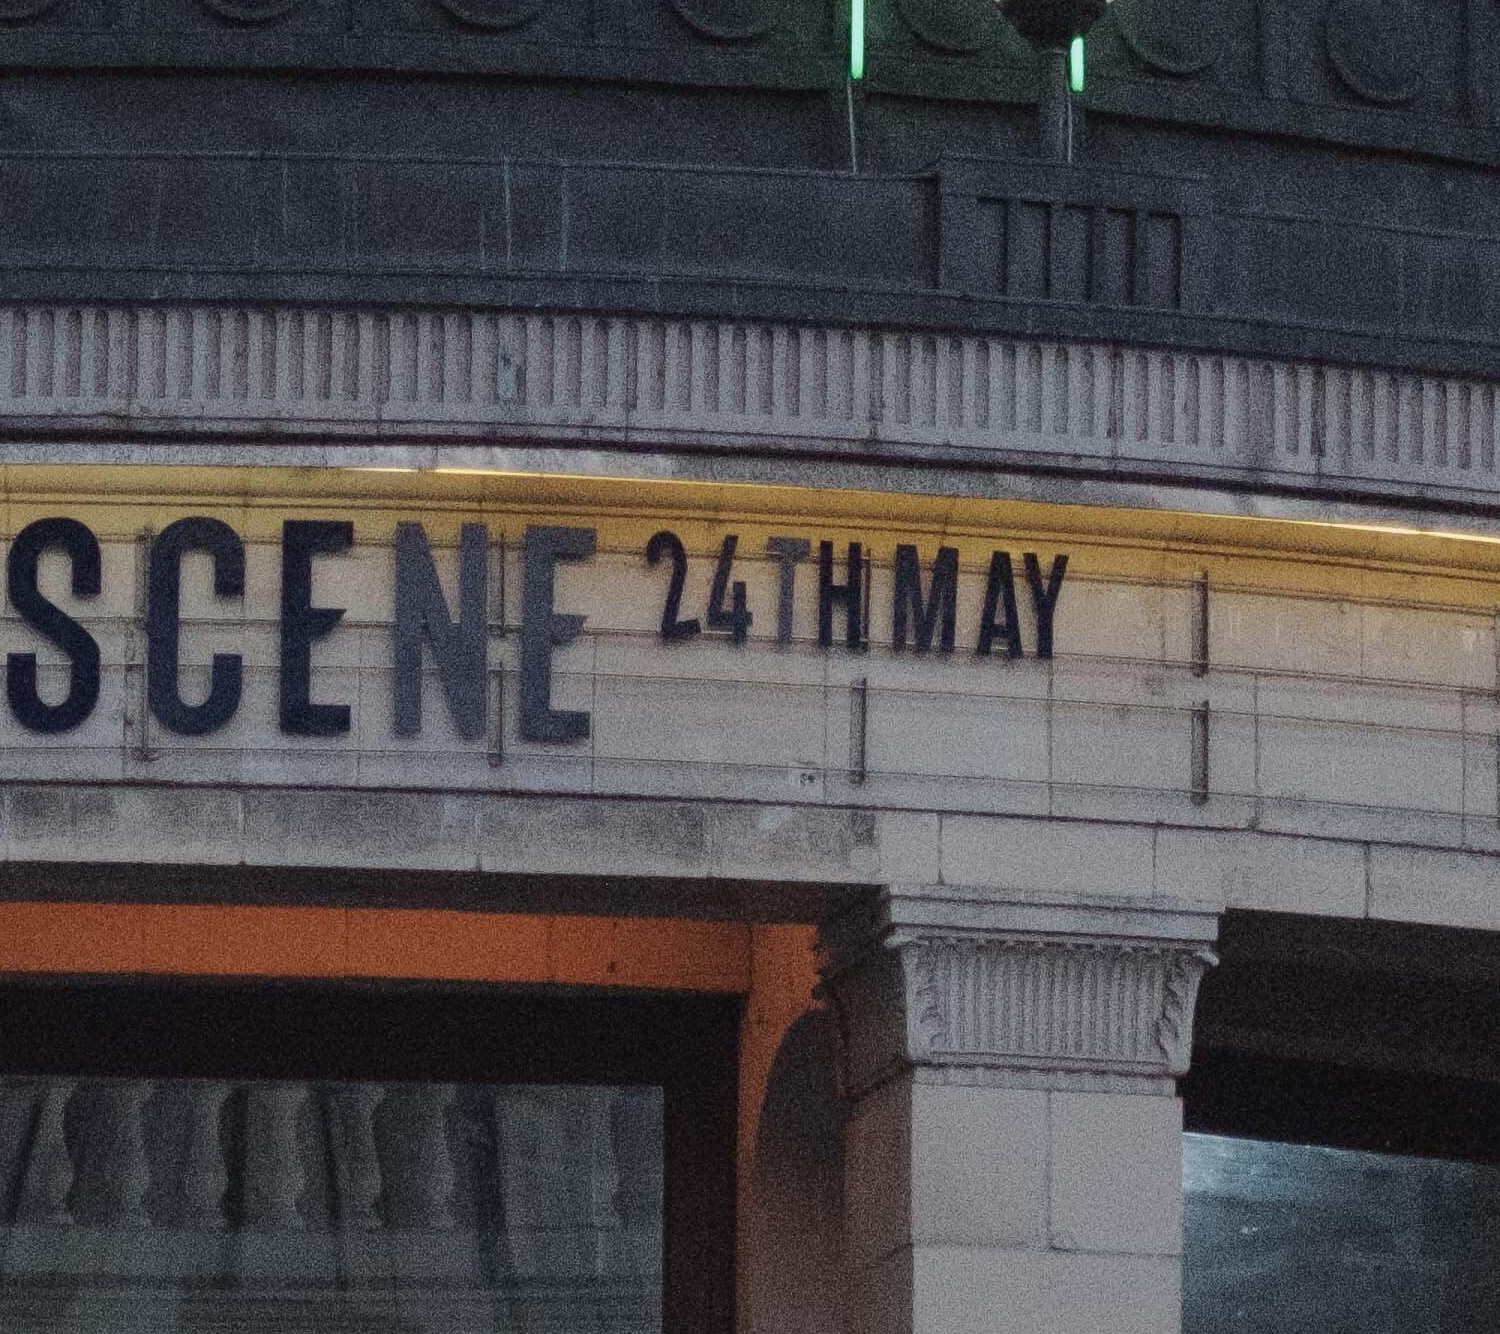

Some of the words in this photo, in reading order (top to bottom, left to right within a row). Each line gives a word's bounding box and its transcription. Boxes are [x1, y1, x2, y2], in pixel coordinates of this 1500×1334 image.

[6, 516, 598, 745] SCENE
[646, 530, 862, 650] 24TH
[892, 543, 1069, 659] MAY
